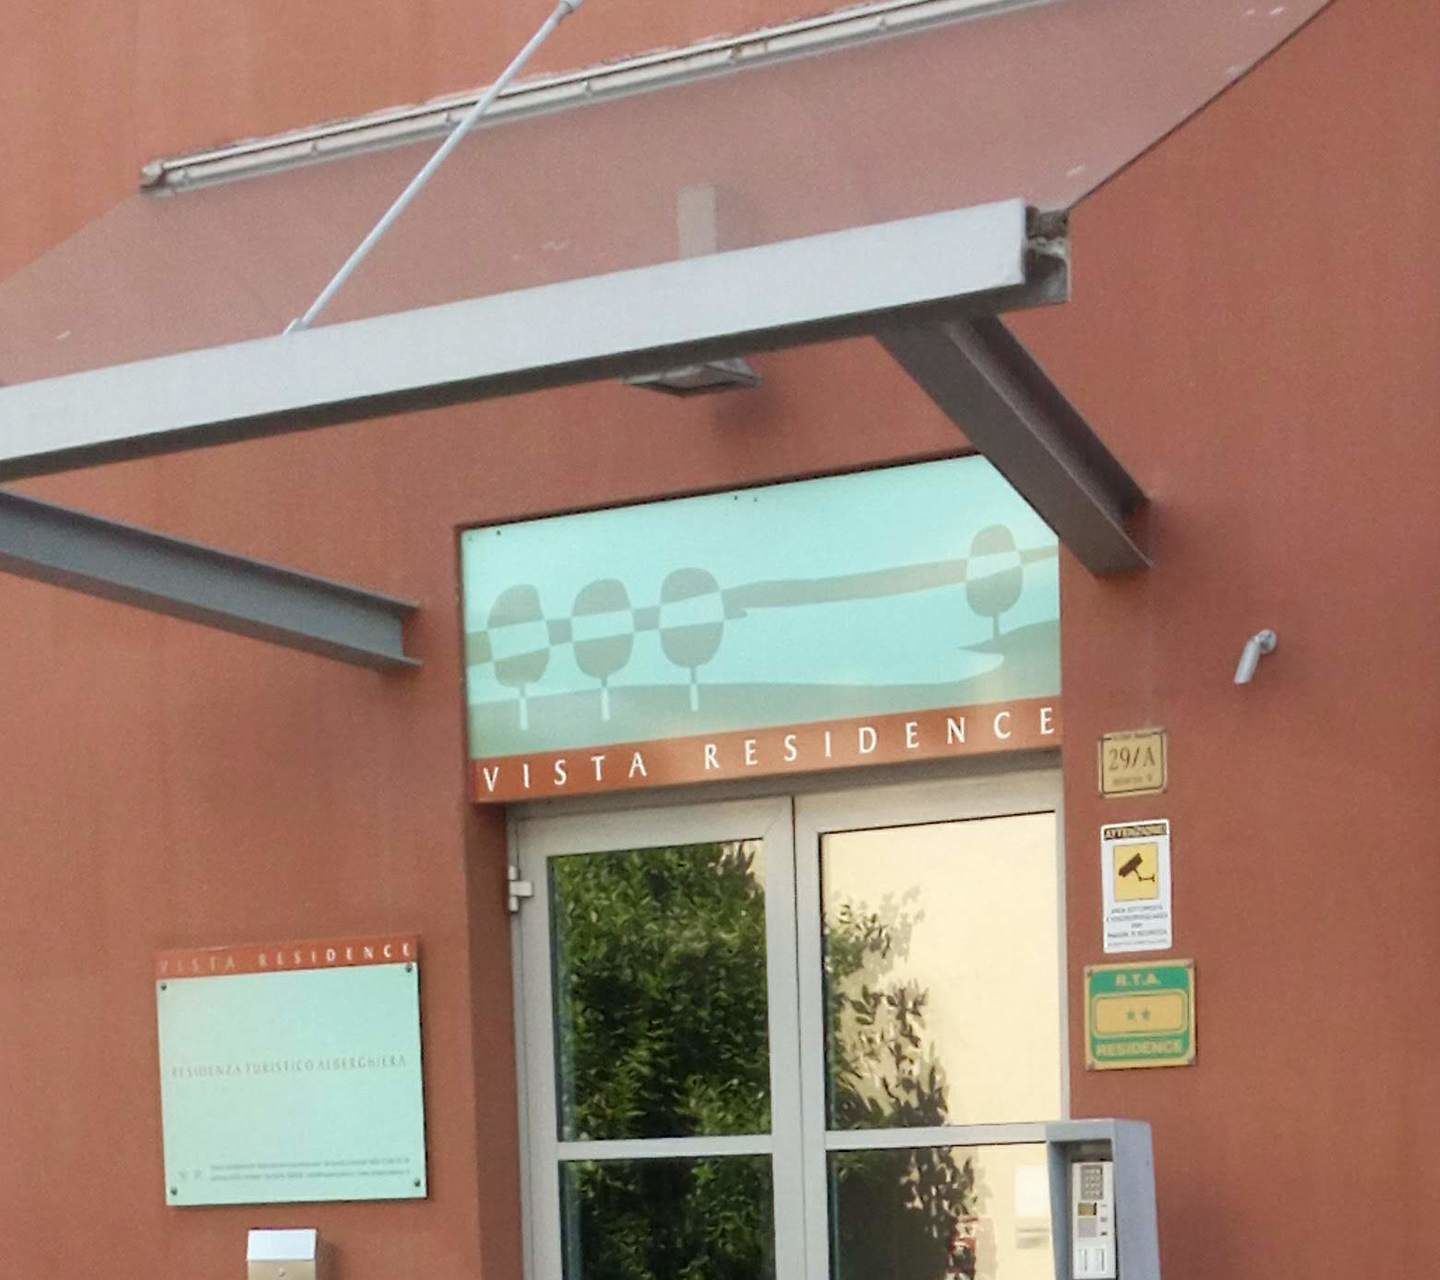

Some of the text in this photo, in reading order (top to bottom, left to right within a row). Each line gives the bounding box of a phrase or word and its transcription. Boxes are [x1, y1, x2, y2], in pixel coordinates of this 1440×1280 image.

[483, 707, 1054, 793] VISTA RESIDENCE
[1108, 746, 1156, 770] 29/A
[258, 942, 411, 967] RESIDENCE
